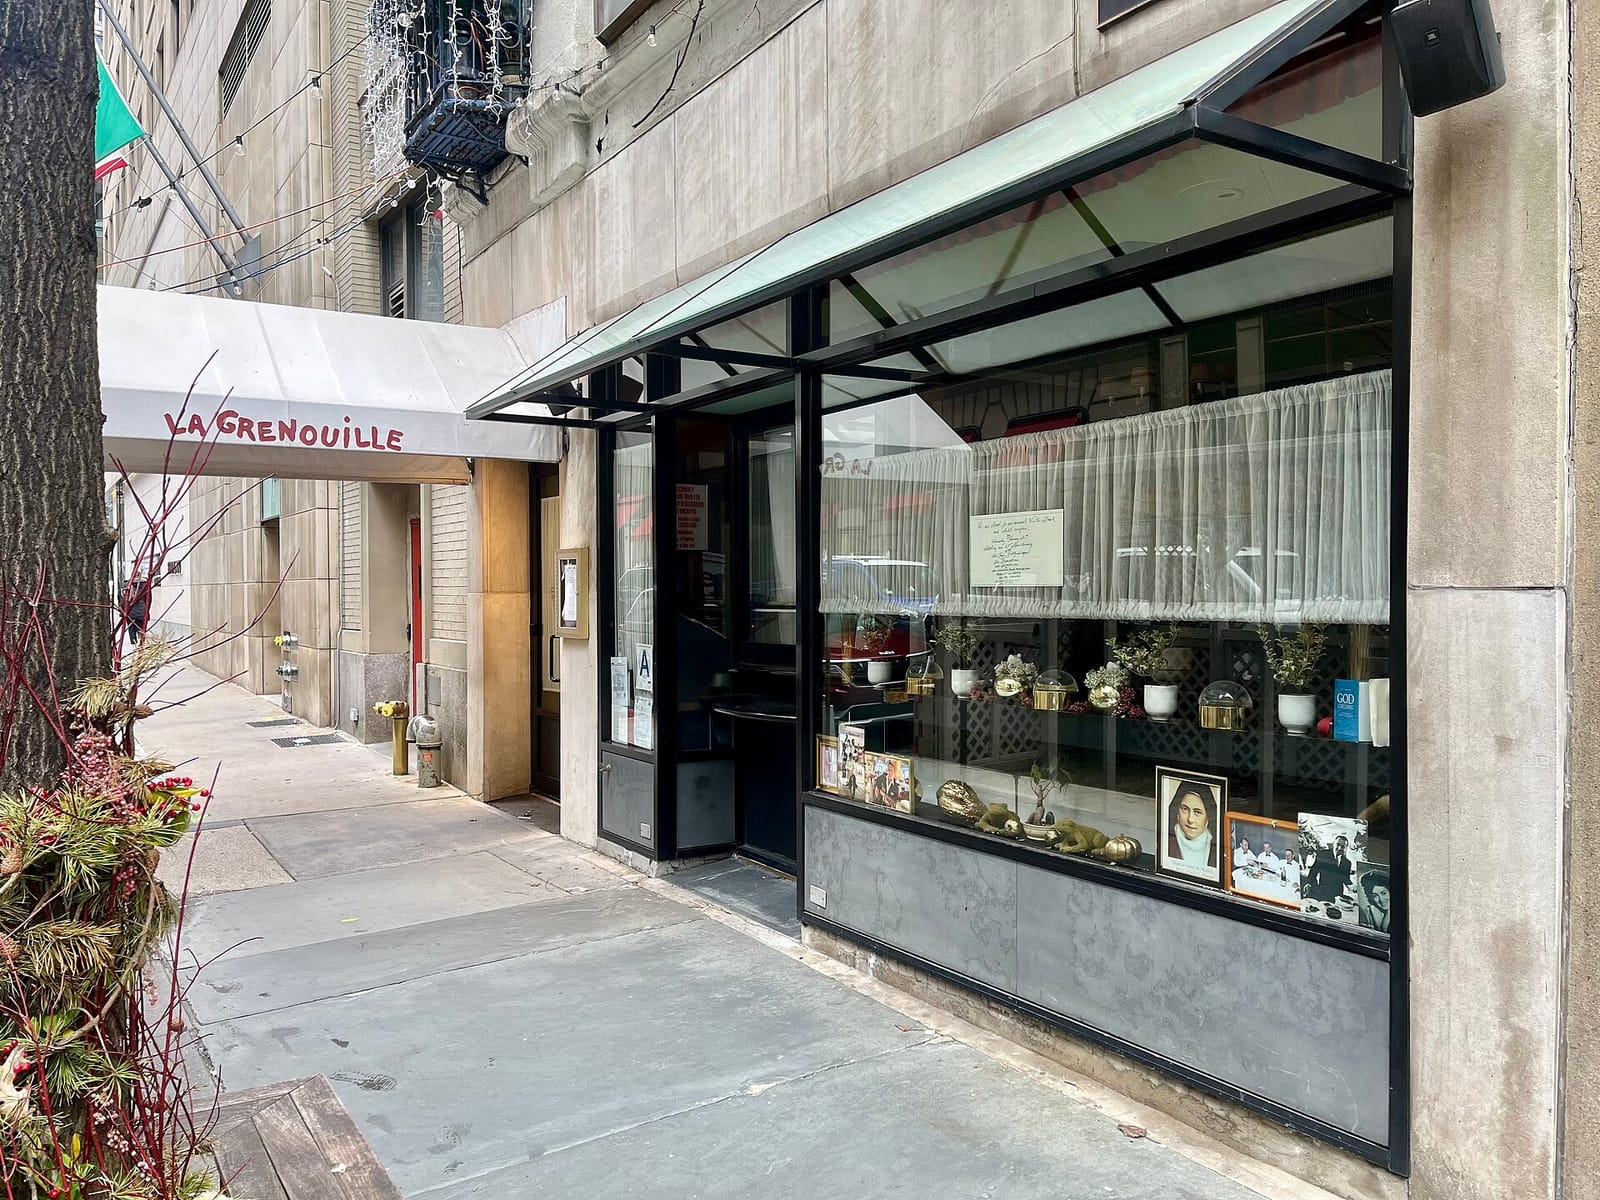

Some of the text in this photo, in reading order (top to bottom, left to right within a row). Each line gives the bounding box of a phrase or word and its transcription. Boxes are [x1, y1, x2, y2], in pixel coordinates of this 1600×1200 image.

[164, 412, 206, 438] LA
[639, 649, 650, 678] A
[1336, 692, 1355, 705] GOD
